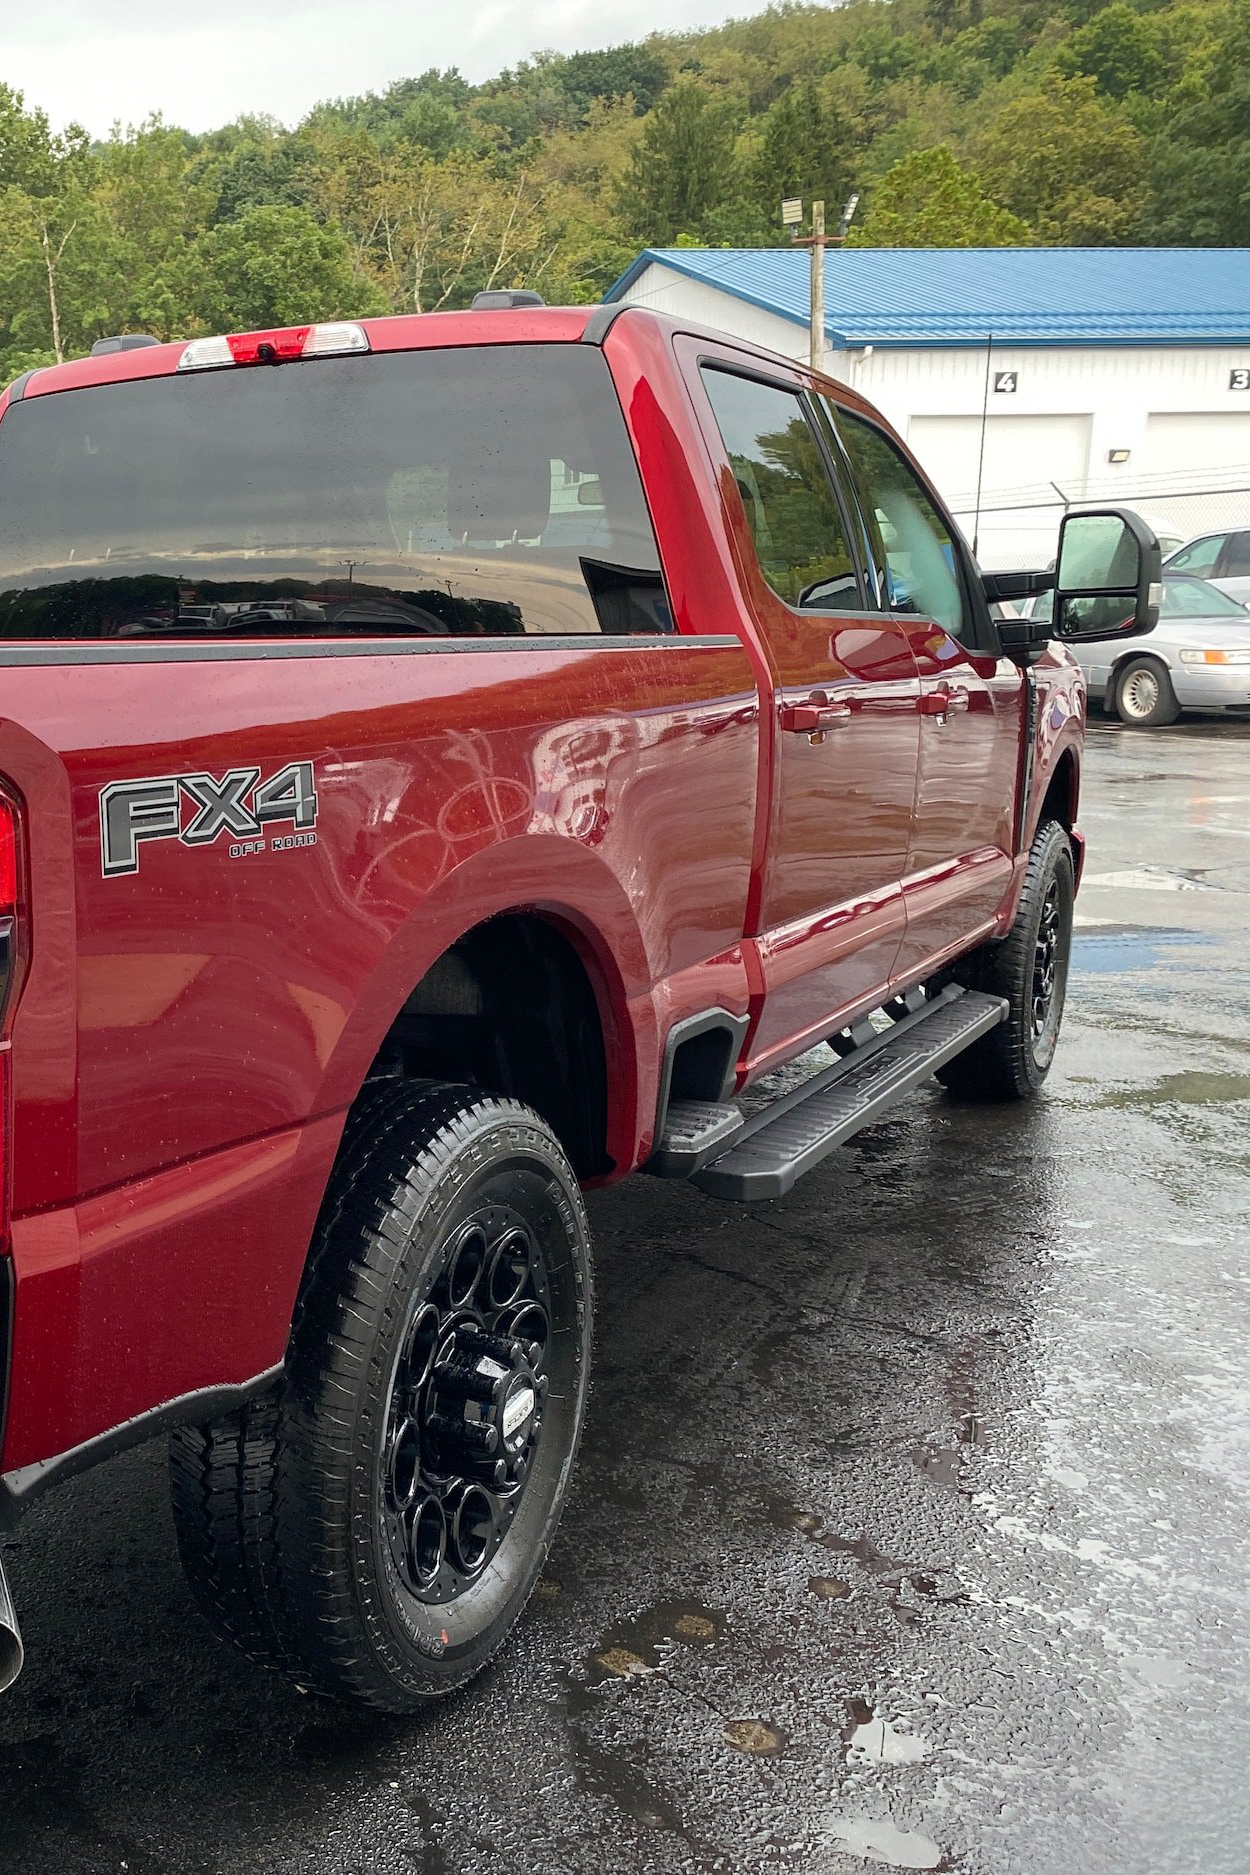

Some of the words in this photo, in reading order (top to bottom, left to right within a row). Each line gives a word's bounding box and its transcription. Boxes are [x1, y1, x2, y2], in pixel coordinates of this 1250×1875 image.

[996, 372, 1015, 392] 4
[1232, 369, 1250, 389] 3
[100, 761, 318, 878] FX4
[229, 839, 265, 858] OFF
[271, 832, 318, 852] ROAD
